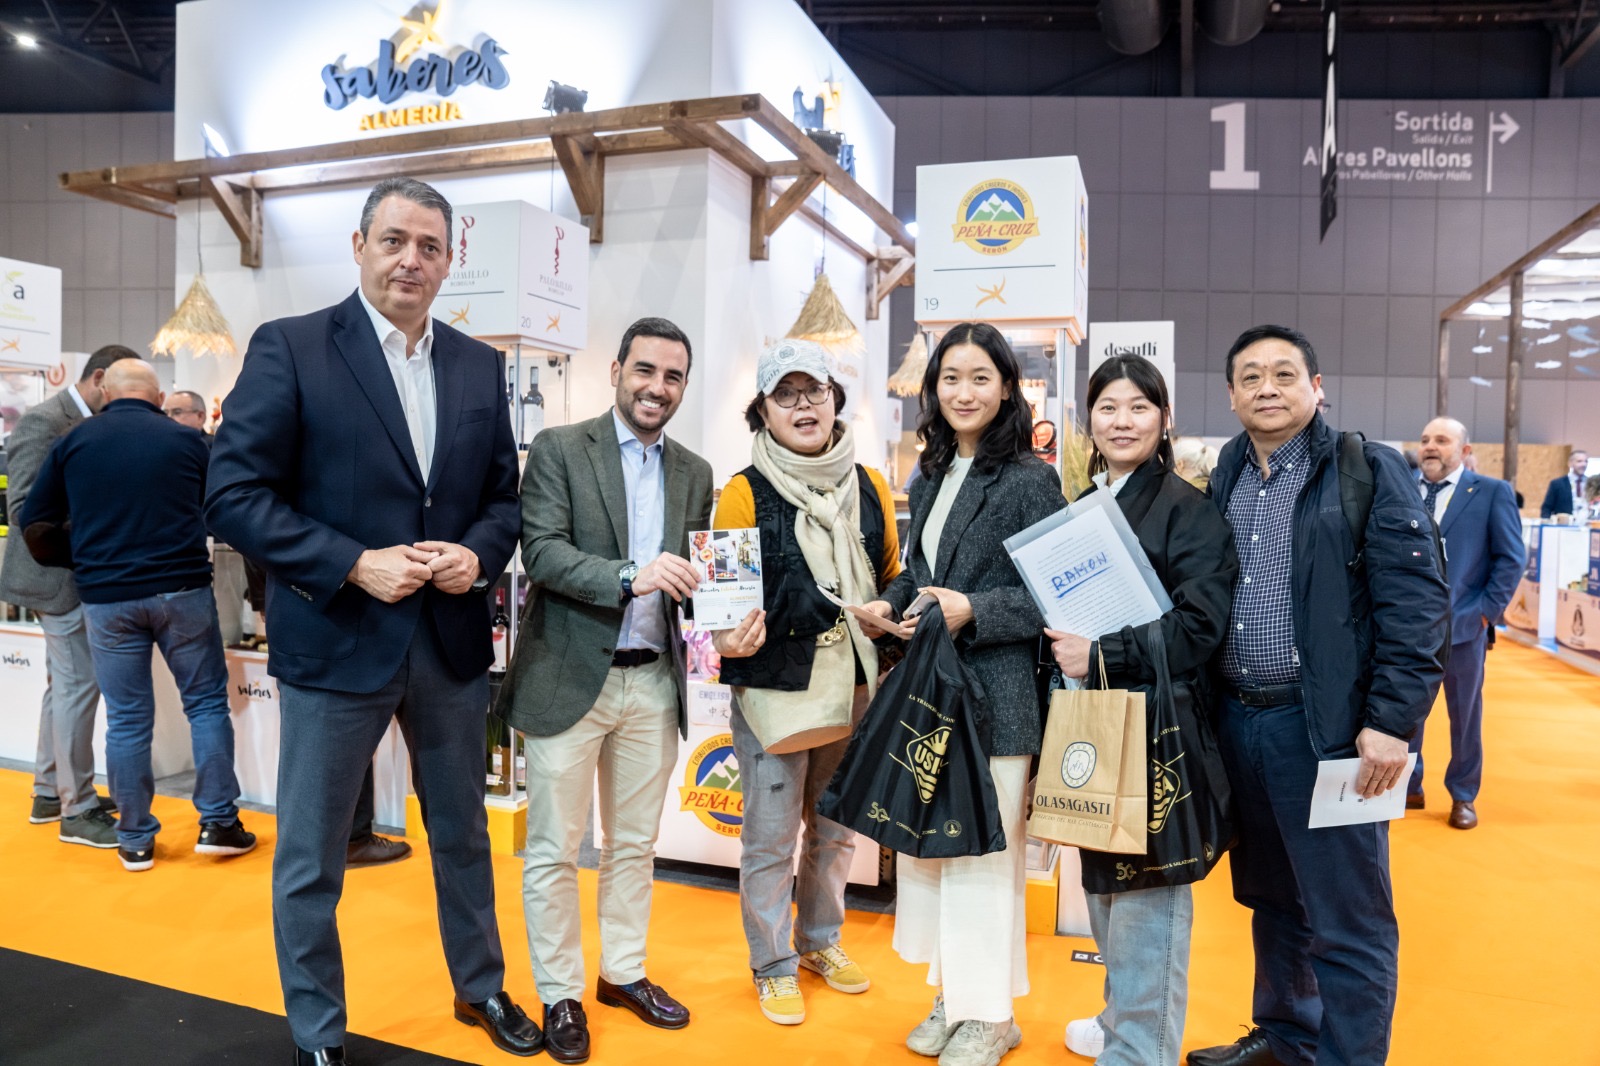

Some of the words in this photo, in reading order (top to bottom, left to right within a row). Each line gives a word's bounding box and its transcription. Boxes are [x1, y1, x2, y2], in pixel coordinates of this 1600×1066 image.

[1394, 111, 1474, 132] Sortida
[1210, 102, 1260, 190] 1
[1453, 134, 1474, 145] Exit
[1372, 147, 1473, 168] Pavellons
[1415, 169, 1444, 181] Other
[924, 298, 939, 310] 19
[521, 316, 532, 328] 20
[1051, 552, 1108, 591] RAMON
[708, 706, 729, 719] 中文
[692, 739, 720, 766] EMBUTIDOS
[1036, 794, 1111, 816] OLASAGASTI
